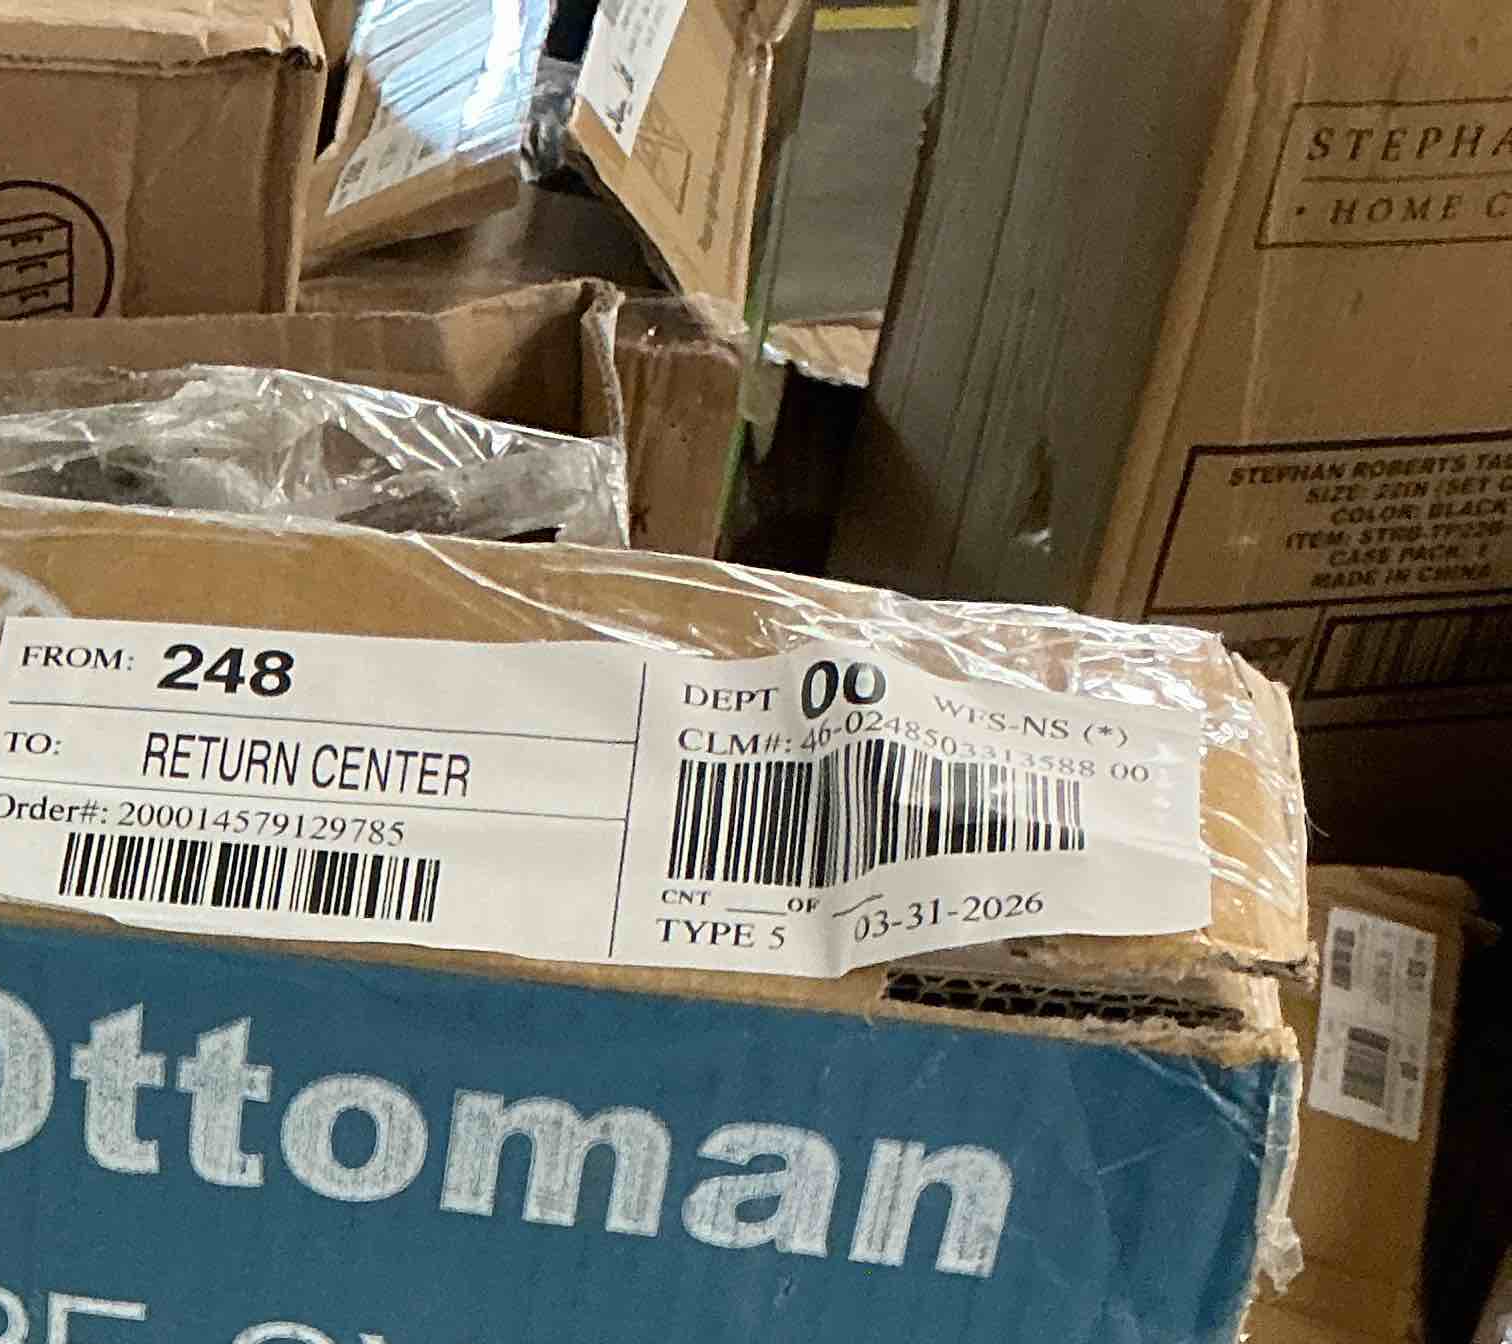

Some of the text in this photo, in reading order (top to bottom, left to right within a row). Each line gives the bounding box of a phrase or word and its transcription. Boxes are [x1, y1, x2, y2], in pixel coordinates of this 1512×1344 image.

[1330, 192, 1464, 225] HOME
[1229, 455, 1467, 486] STEPHAN ROBERTS
[1311, 569, 1378, 588] MADE
[20, 643, 297, 697] FROM: 248
[683, 659, 887, 720] DEPT 00
[3, 731, 472, 797] TO: RETURN CENTER
[677, 728, 793, 757] CLM#:
[1110, 762, 1151, 784] 00
[117, 801, 405, 848] 200014579129785
[655, 892, 1045, 950] TYPE 5 03-31-2026
[661, 889, 821, 914] CNT OF
